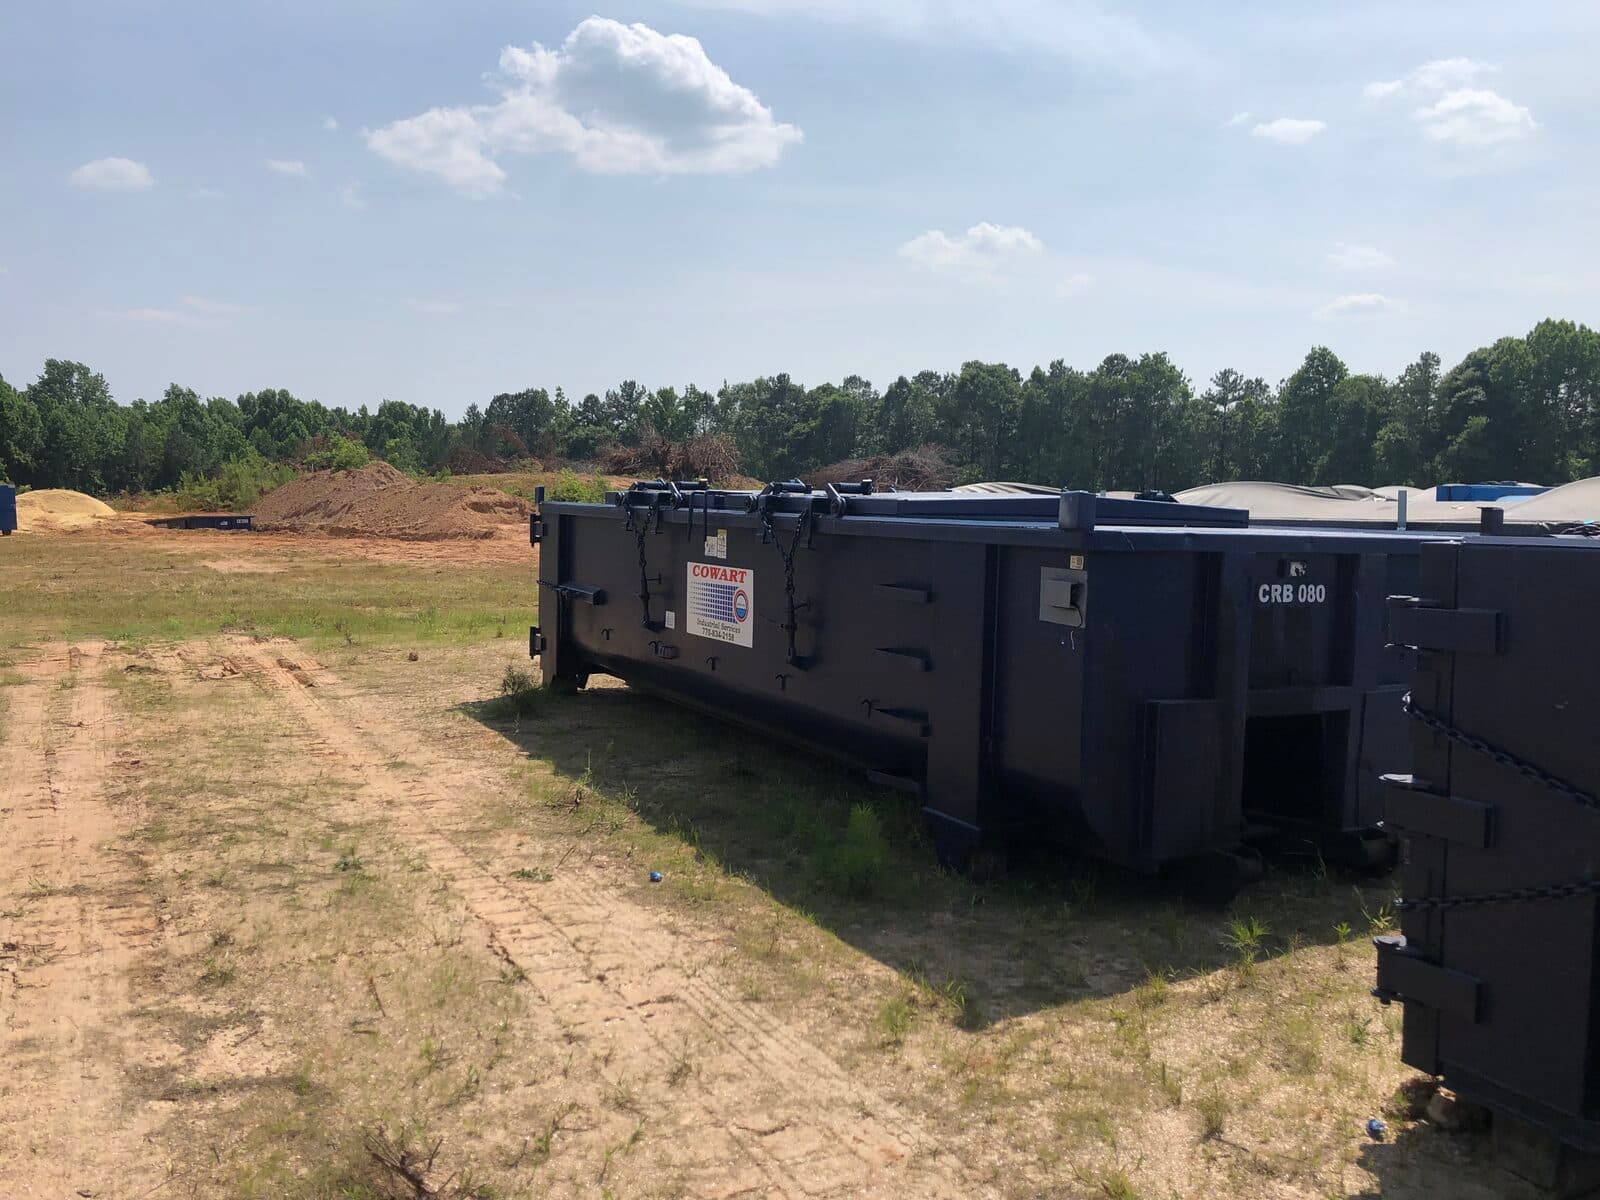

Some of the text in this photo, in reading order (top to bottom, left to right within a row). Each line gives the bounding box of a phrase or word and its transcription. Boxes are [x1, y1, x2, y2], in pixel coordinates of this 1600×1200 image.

[692, 565, 747, 583] COWART
[1258, 584, 1326, 603] CRB 080
[696, 617, 720, 629] Industrial
